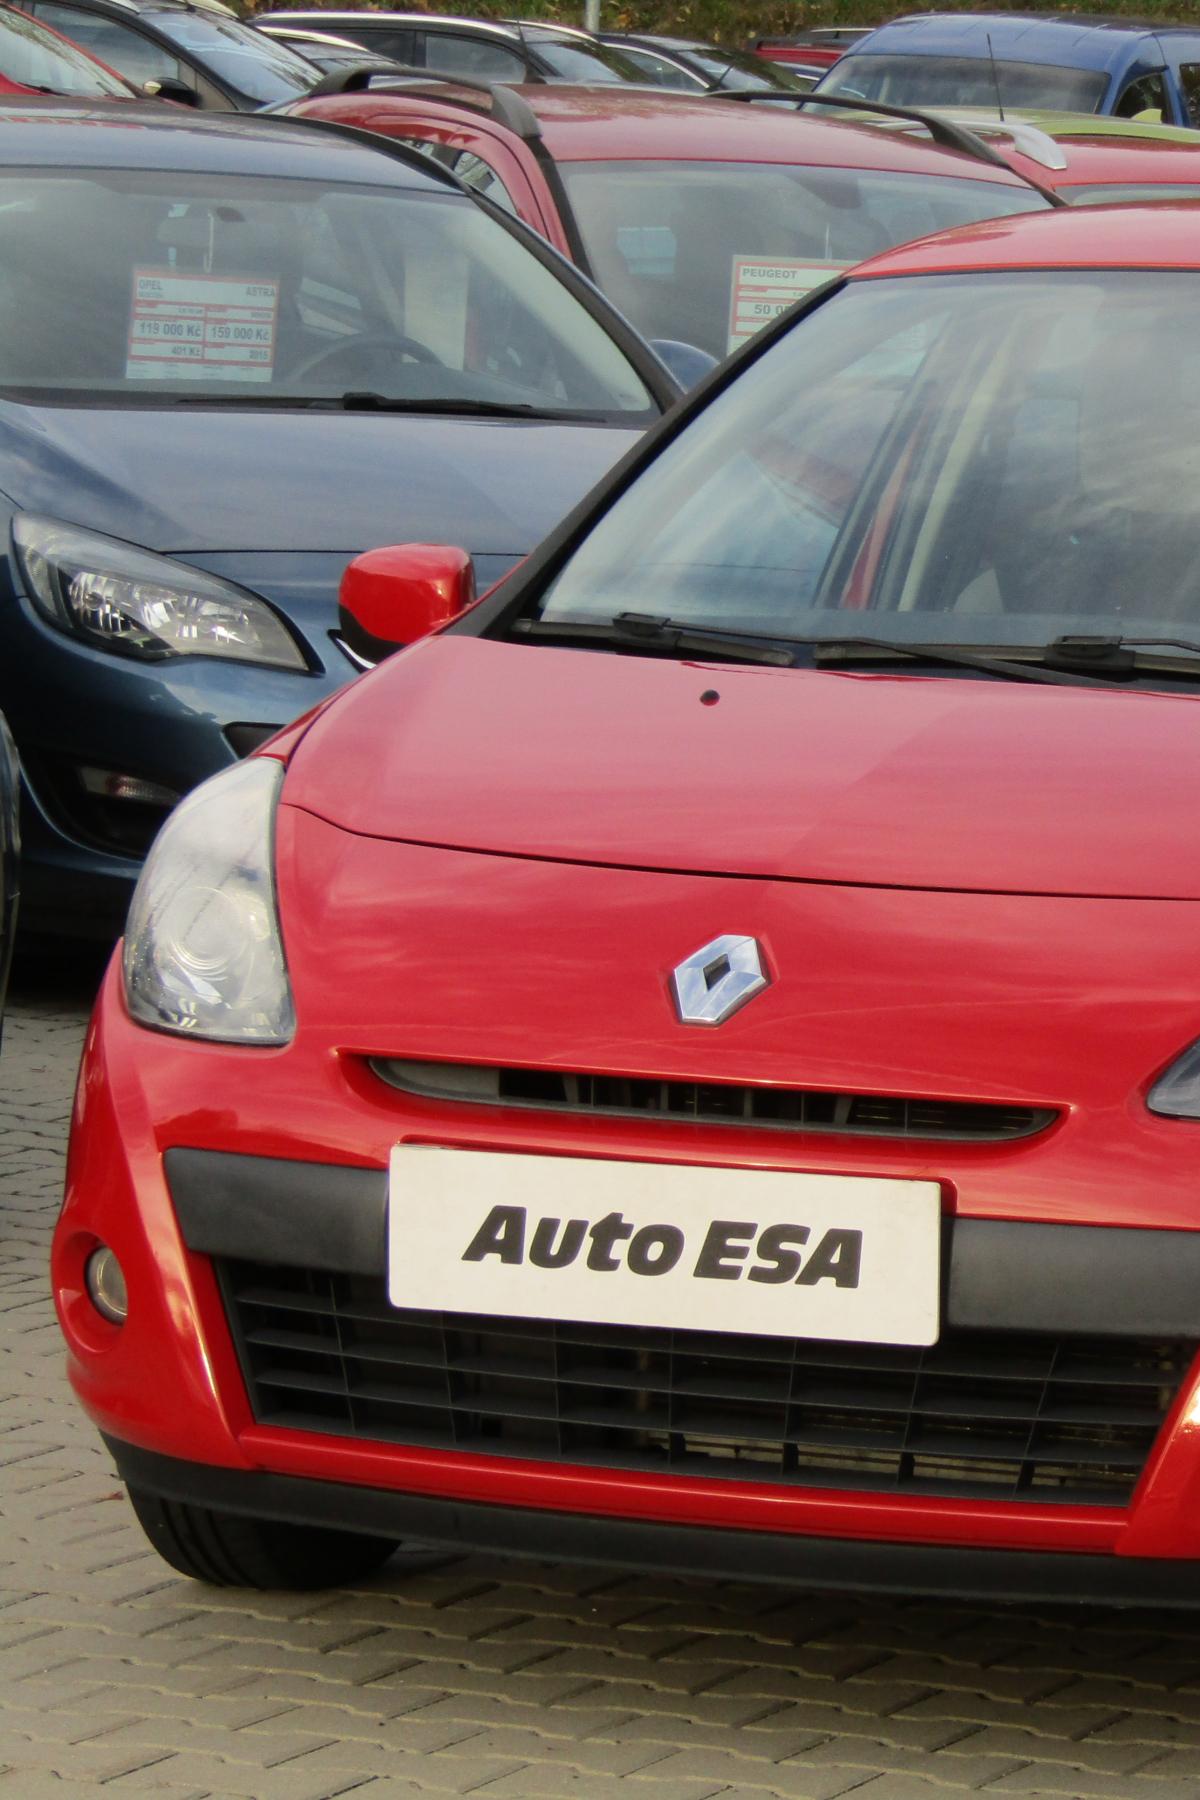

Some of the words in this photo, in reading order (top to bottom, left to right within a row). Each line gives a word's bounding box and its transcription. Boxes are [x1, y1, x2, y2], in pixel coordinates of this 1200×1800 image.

[742, 268, 798, 279] PEUGEOT
[138, 279, 163, 291] OPEL
[246, 286, 275, 297] ASTRA
[754, 304, 771, 315] 50
[163, 323, 184, 336] 000
[233, 327, 253, 340] 000
[460, 1204, 686, 1277] Auto
[692, 1219, 865, 1290] ESA
